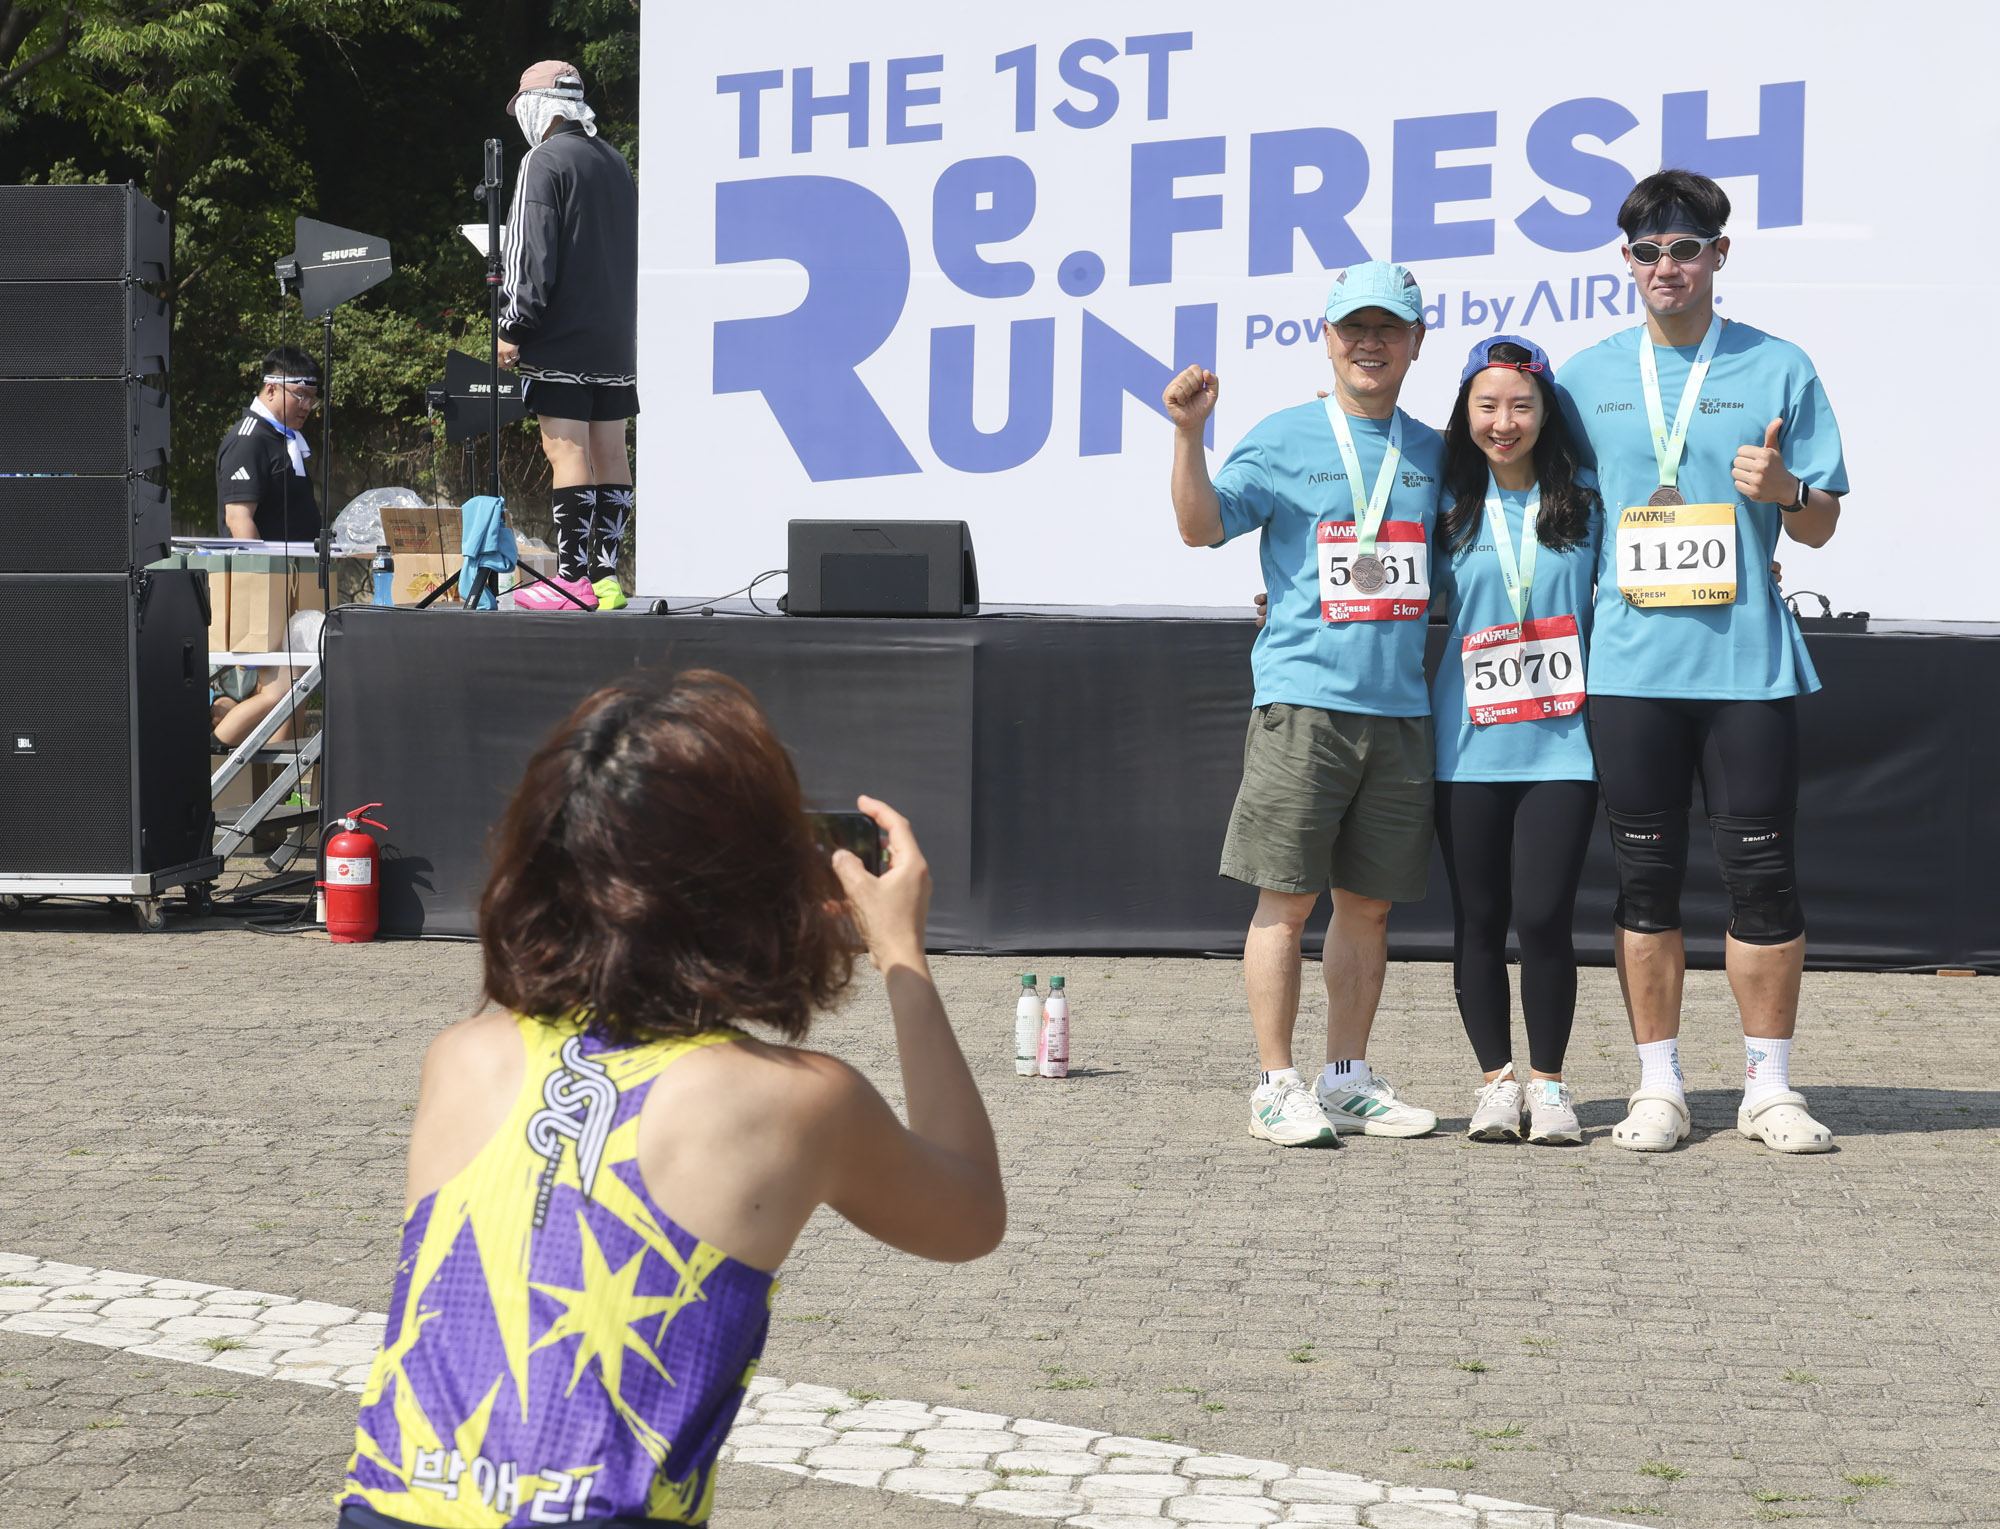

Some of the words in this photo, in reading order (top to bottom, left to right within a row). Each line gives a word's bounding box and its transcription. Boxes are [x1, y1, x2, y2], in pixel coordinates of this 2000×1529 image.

[716, 70, 944, 158] THE
[996, 31, 1193, 133] 1ST
[322, 246, 368, 261] SHURE
[1462, 291, 1515, 333] by
[1519, 272, 1724, 328] AIRi.
[1624, 511, 1676, 523] 시사저널
[1629, 539, 1726, 572] 1120
[1330, 555, 1420, 586] 561
[1692, 589, 1706, 600] 10
[1709, 588, 1729, 600] km
[1393, 604, 1401, 616] 5
[1402, 604, 1419, 616] km
[1468, 627, 1519, 646] 시사저널
[1474, 651, 1572, 690] 5070
[1543, 702, 1552, 713] 5
[1554, 699, 1576, 711] km
[17, 738, 32, 748] JBL
[412, 1446, 593, 1521] 박애리
